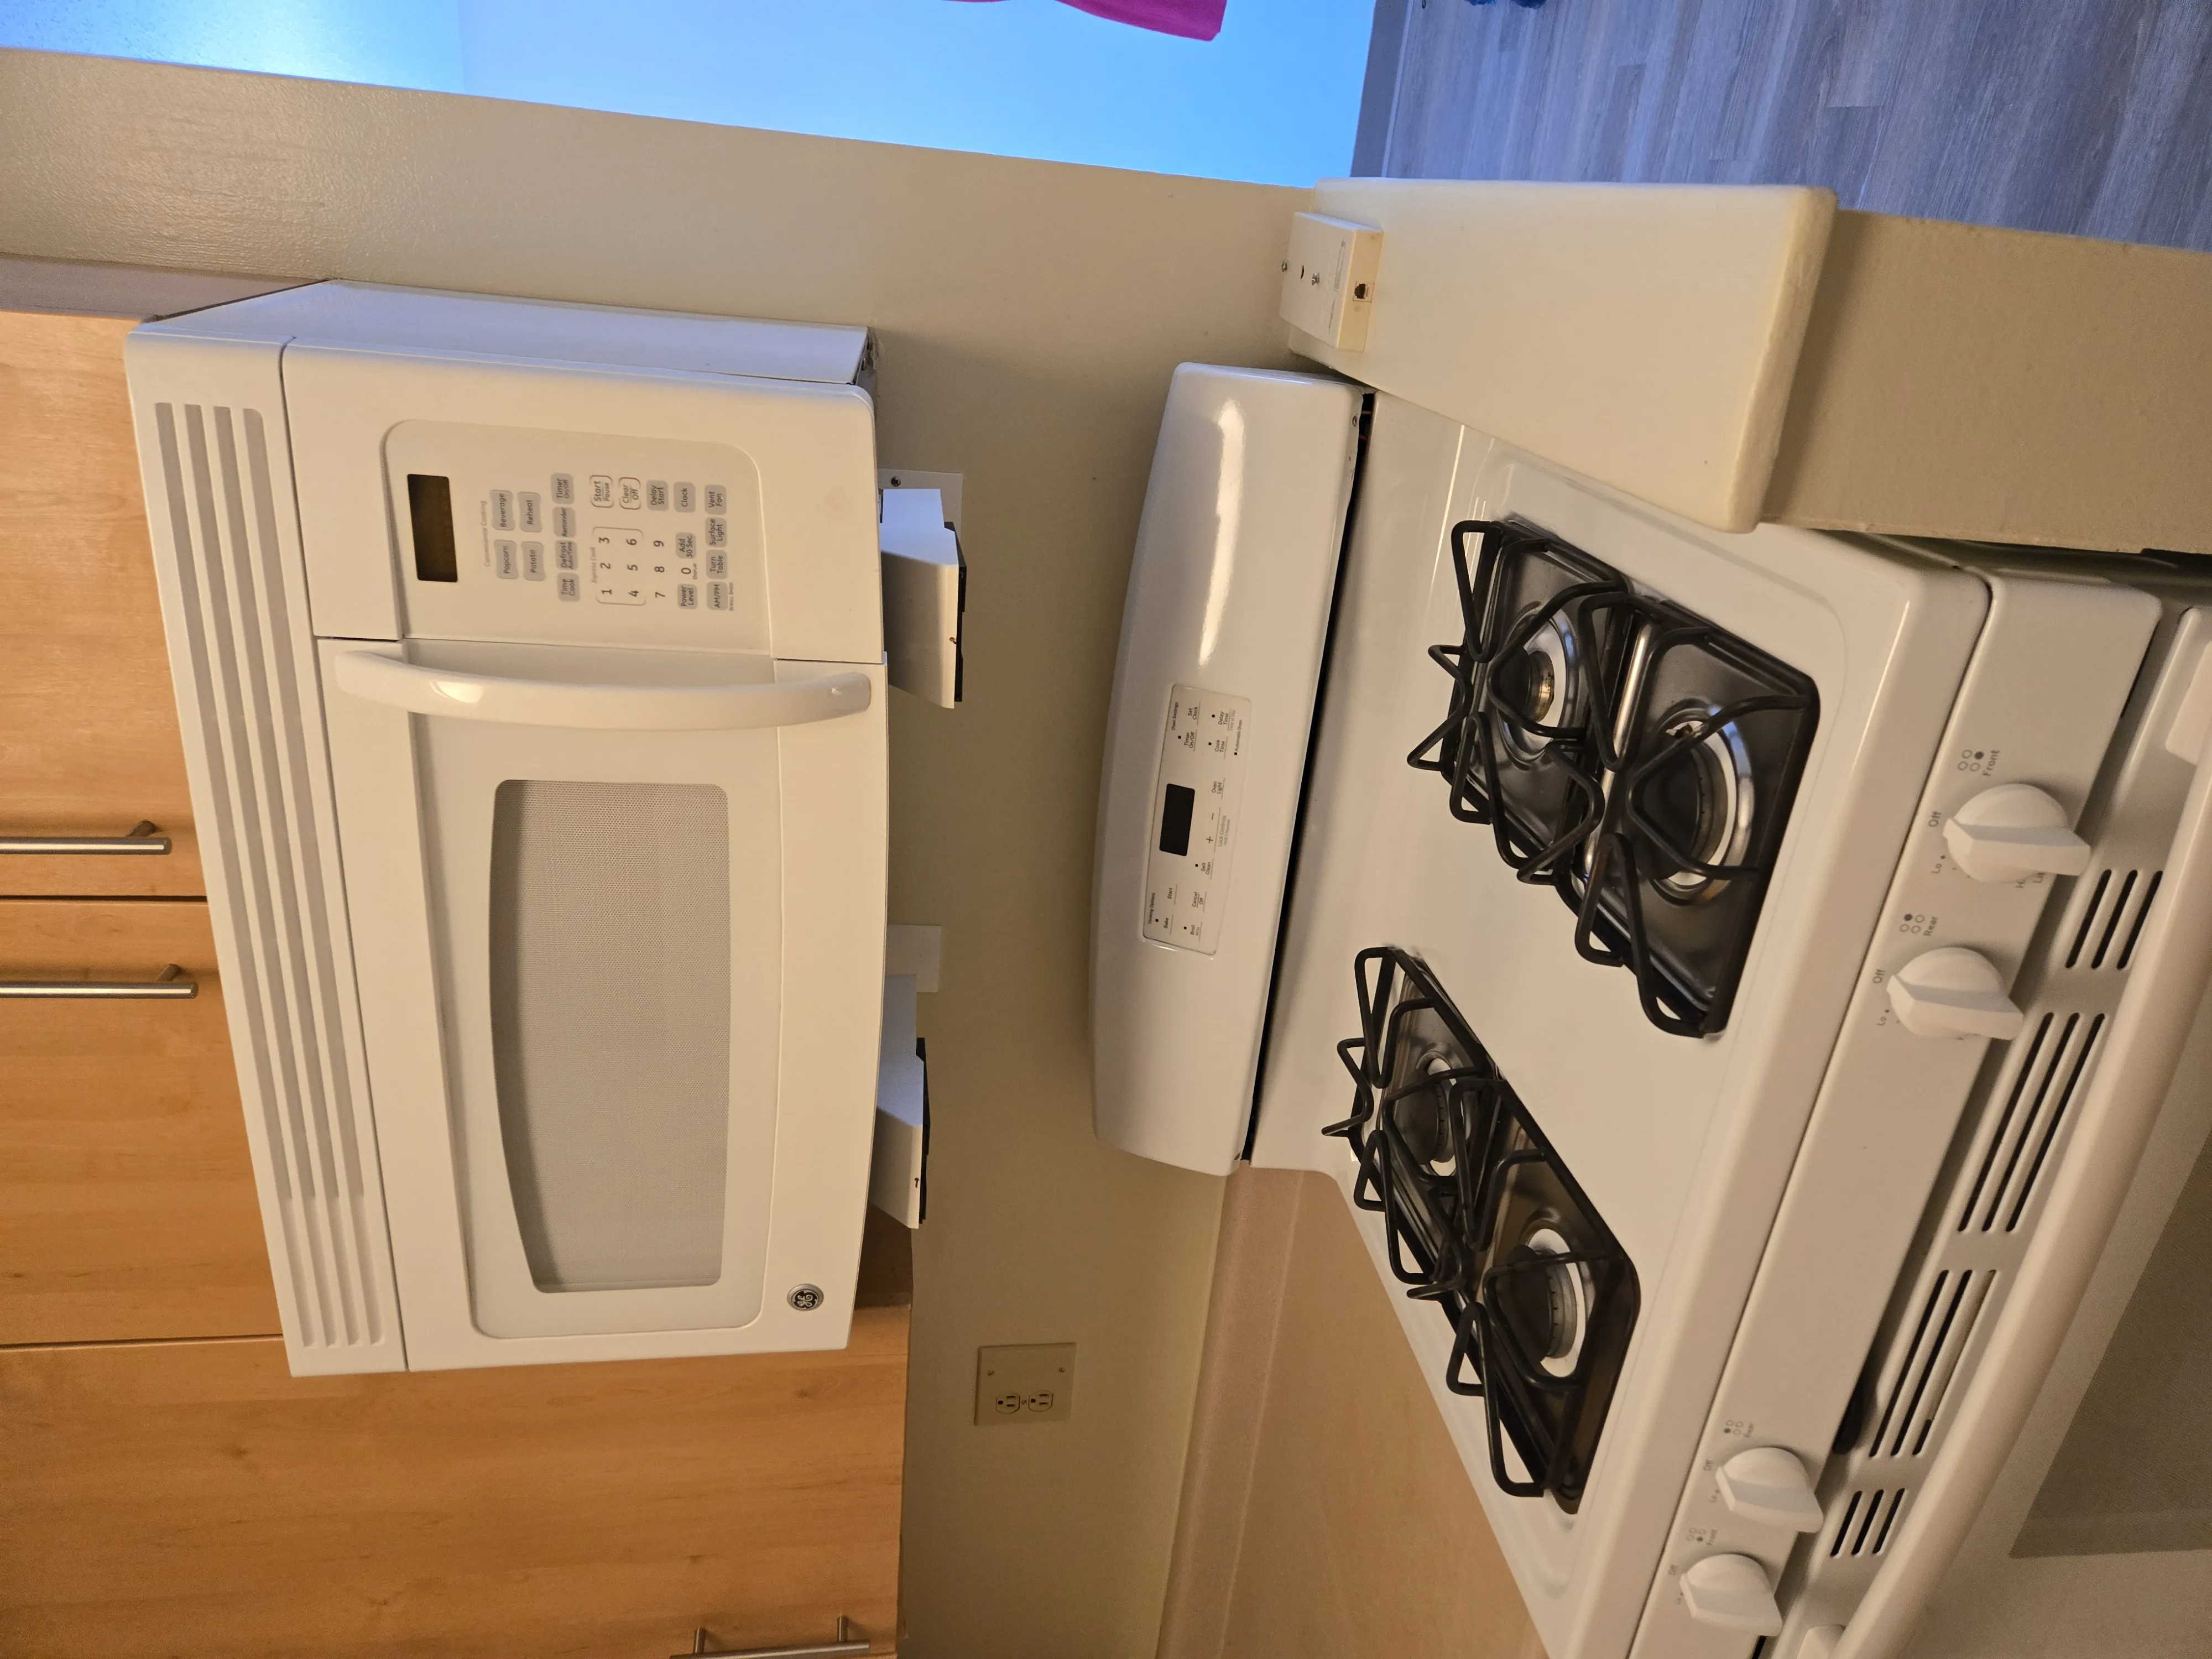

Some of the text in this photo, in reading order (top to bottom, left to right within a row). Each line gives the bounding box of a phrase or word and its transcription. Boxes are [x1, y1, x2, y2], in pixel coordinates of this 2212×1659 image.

[498, 493, 507, 527] Beverage
[716, 524, 724, 541] Light
[686, 549, 693, 557] 30
[1982, 750, 2000, 777] Front
[1928, 811, 1941, 827] Off
[1931, 863, 1942, 874] Lo
[1923, 916, 1938, 936] Rear
[1872, 969, 1886, 984] Off
[1876, 1016, 1887, 1026] Lo
